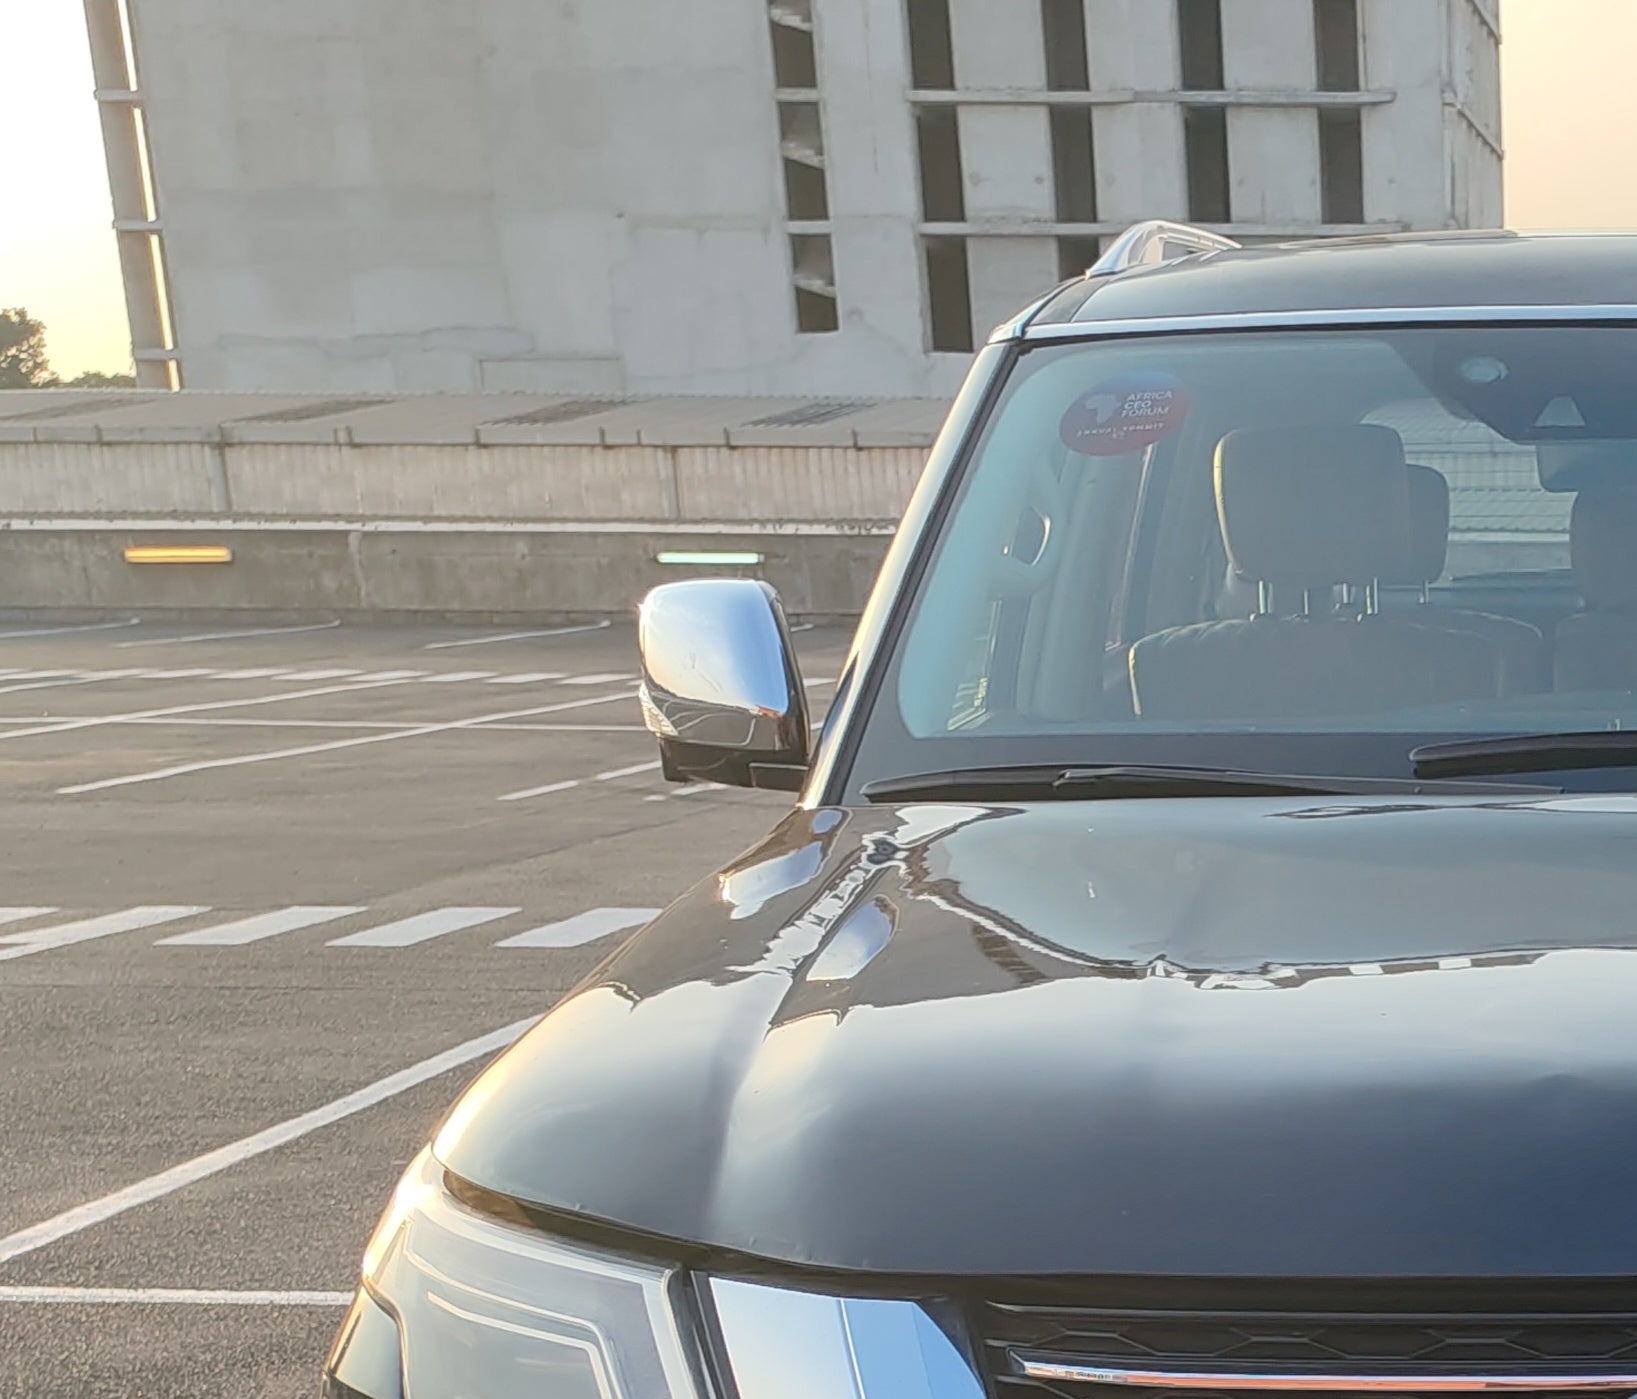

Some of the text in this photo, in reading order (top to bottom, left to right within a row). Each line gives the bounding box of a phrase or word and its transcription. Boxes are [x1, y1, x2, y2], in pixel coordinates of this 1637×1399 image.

[1125, 391, 1173, 402] AFRICA
[1123, 400, 1152, 410] CEO
[1120, 406, 1169, 418] FORUM
